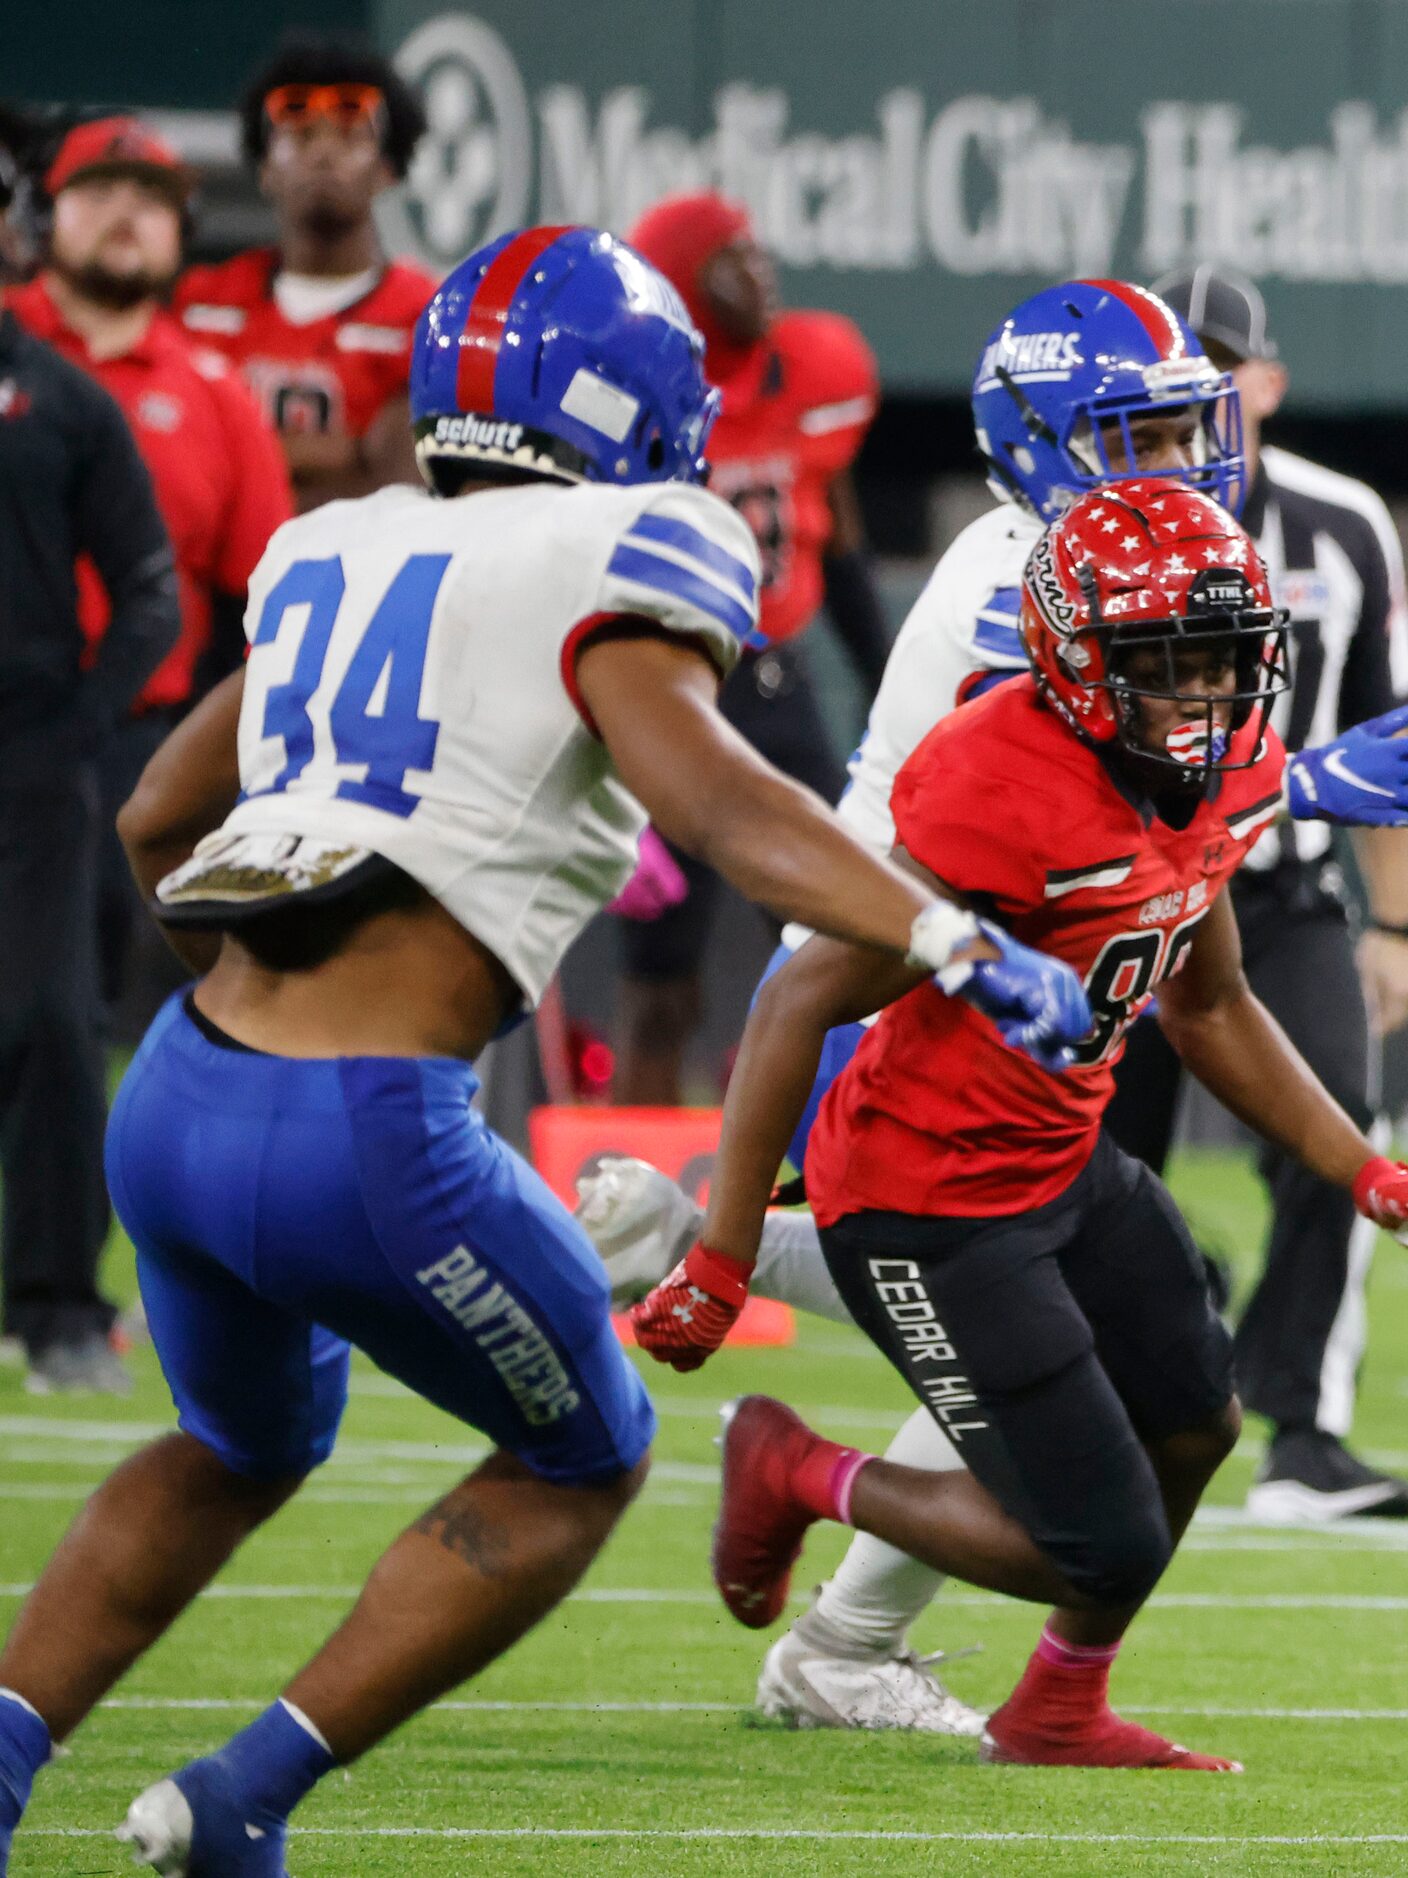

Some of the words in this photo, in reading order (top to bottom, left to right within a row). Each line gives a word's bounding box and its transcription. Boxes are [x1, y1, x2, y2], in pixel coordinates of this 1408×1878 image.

[541, 84, 926, 266] Medical
[926, 92, 1133, 280] City
[435, 411, 525, 450] schutt
[242, 553, 453, 820] 34
[414, 1243, 582, 1426] PANTHERS
[867, 1258, 958, 1363] CEDAR
[921, 1375, 990, 1442] HILL
